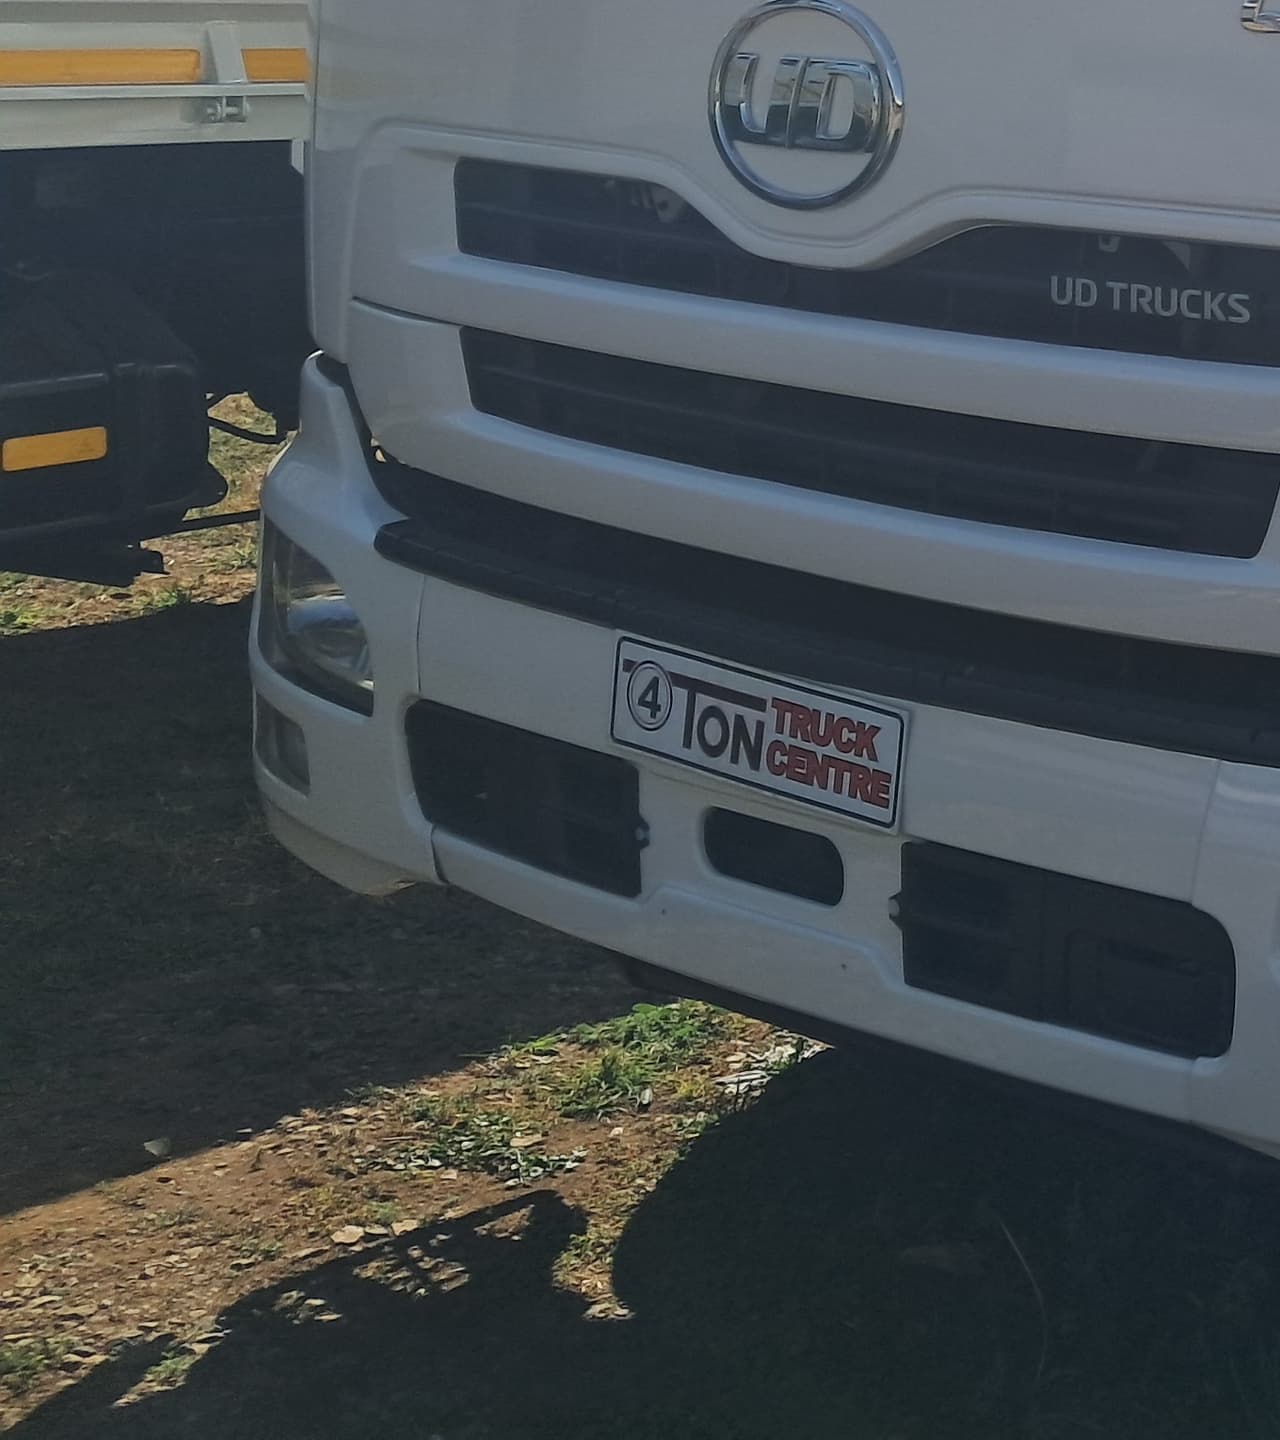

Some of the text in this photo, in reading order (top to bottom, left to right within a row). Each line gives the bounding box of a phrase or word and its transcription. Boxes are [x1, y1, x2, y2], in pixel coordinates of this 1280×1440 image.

[723, 52, 882, 154] UD
[1050, 275, 1251, 324] UD TRUCKS
[637, 670, 768, 772] 4 TON
[770, 696, 882, 762] TRUCK
[765, 739, 893, 810] CENTRE
